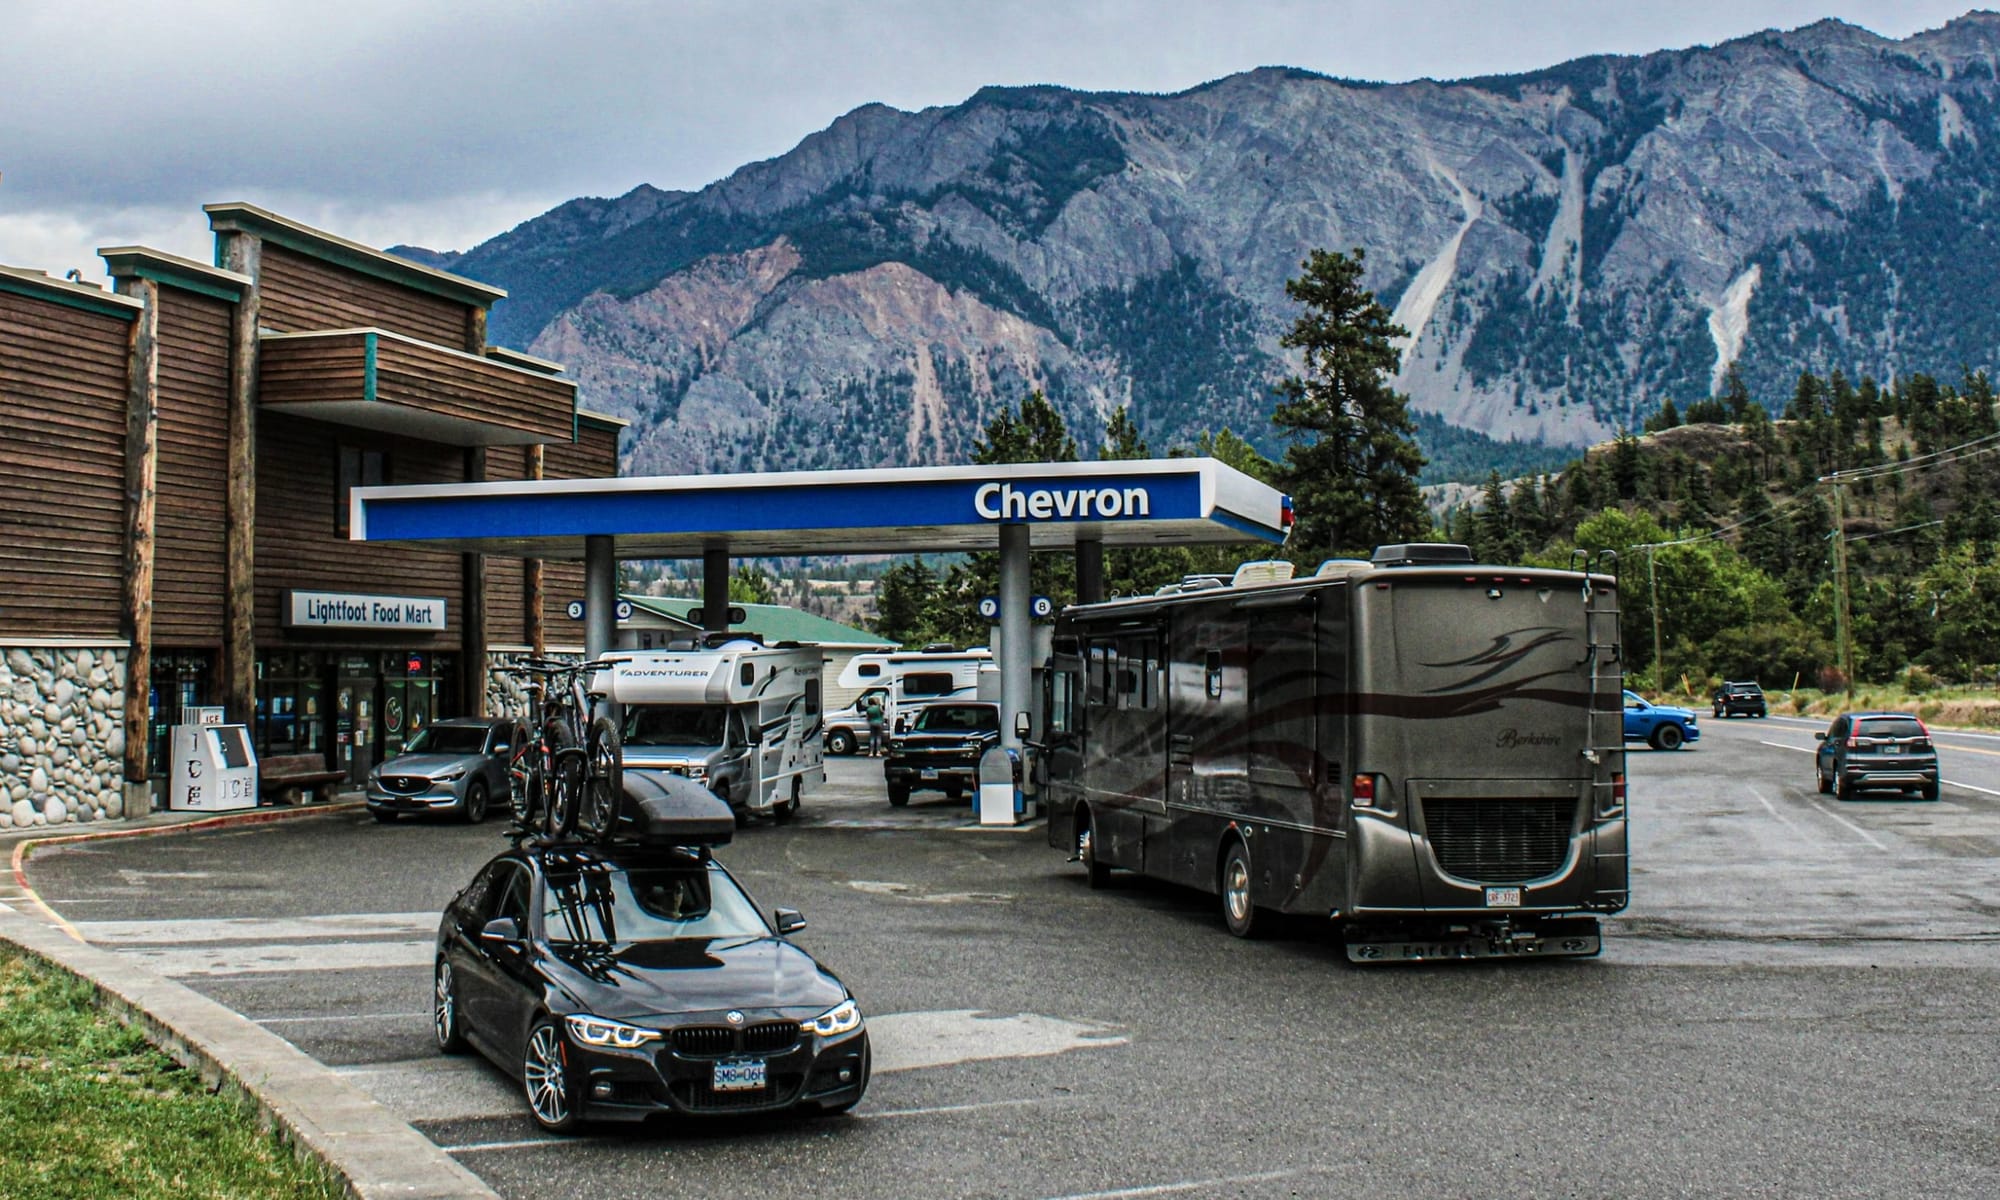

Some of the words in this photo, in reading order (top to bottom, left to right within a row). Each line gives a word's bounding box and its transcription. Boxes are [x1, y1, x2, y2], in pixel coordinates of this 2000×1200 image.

[974, 482, 1150, 519] Chevron
[308, 599, 367, 624] Lightfoot
[373, 602, 400, 623] Food
[405, 604, 432, 623] Mart
[625, 669, 709, 677] ADVENTURER
[1495, 727, 1562, 749] Berkshire
[221, 777, 253, 799] ICE
[1402, 945, 1474, 957] Forest
